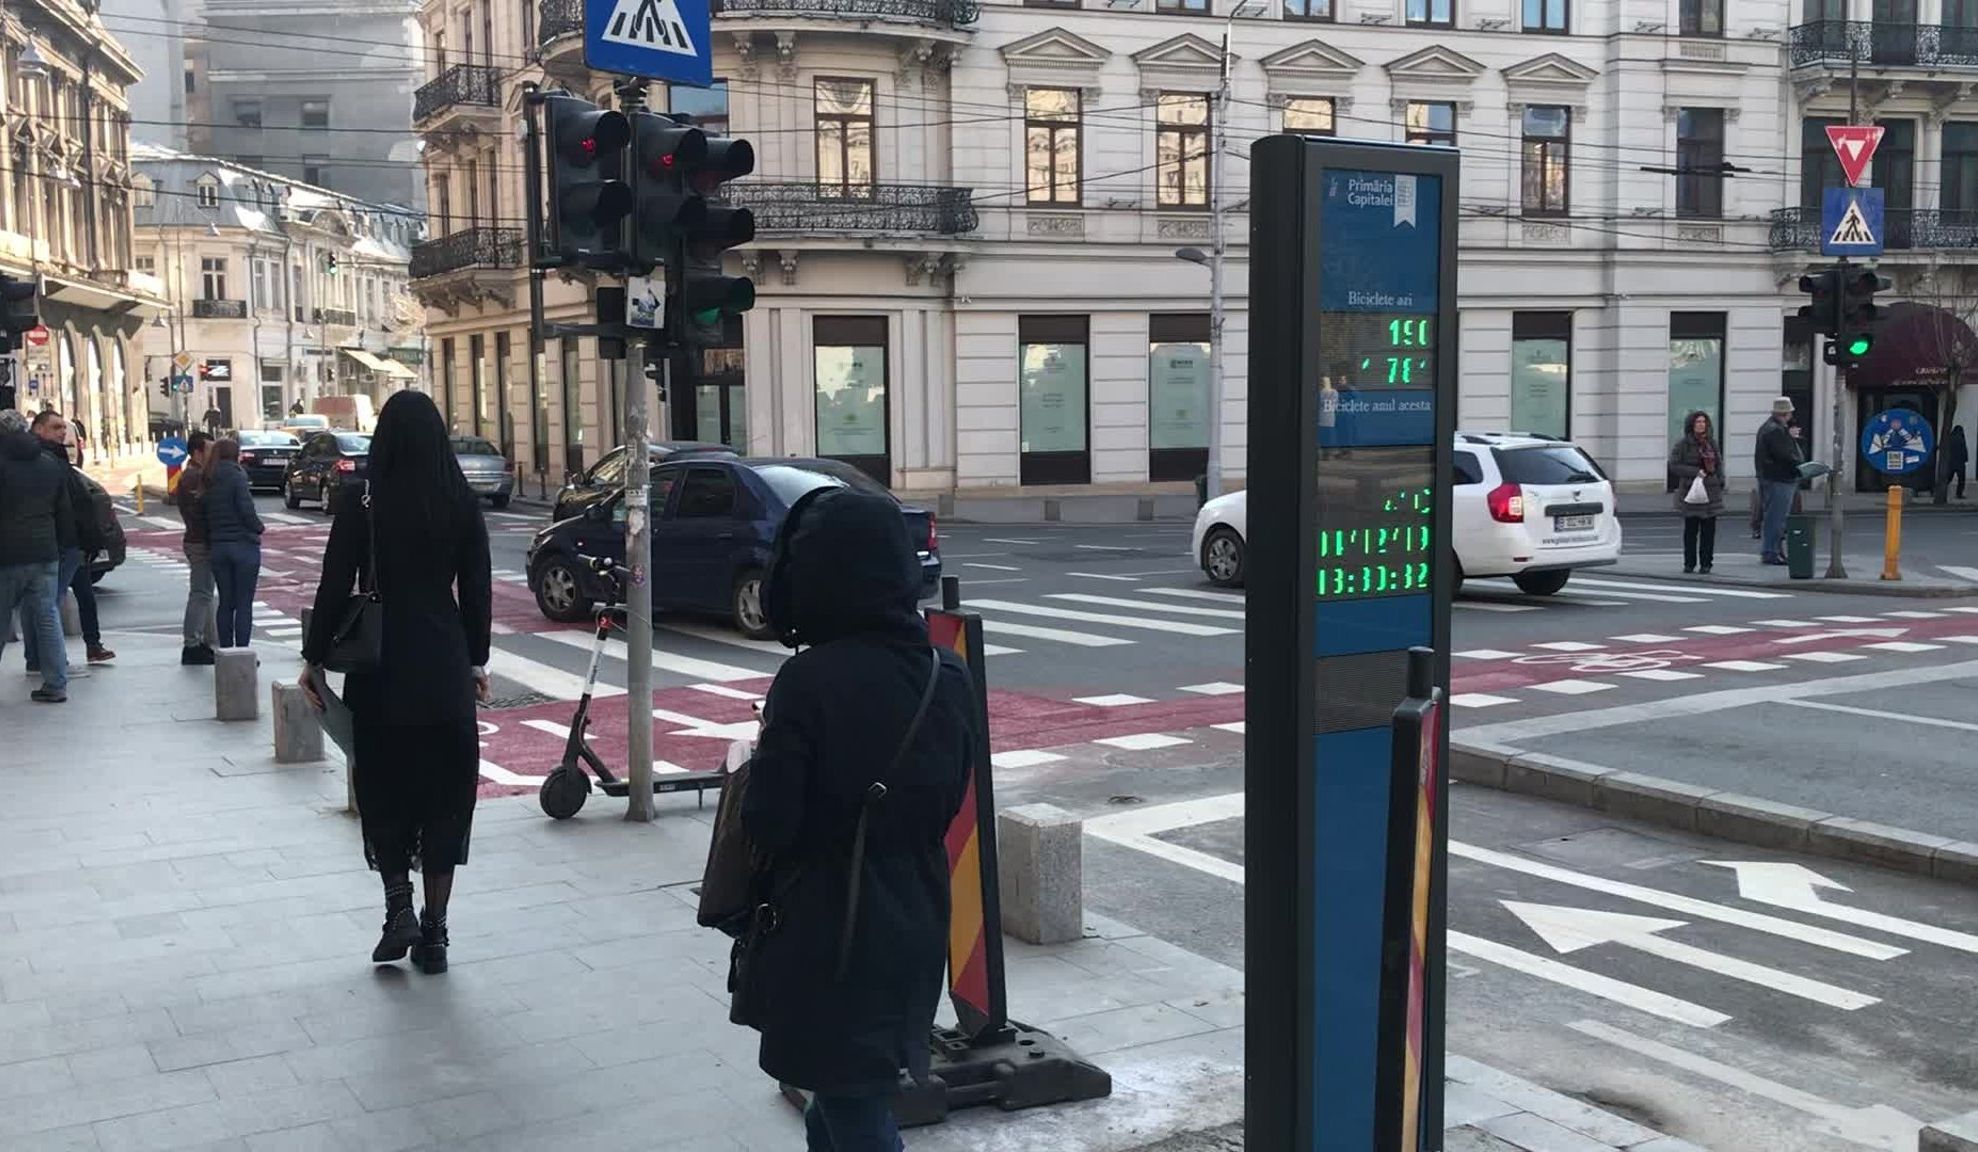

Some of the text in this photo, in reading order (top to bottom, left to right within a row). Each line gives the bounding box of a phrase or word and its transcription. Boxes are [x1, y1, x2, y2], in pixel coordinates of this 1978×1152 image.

[1347, 192, 1394, 208] Capitalei
[1348, 291, 1393, 306] Biciclete
[1323, 399, 1431, 412] Biciclete anul acesta
